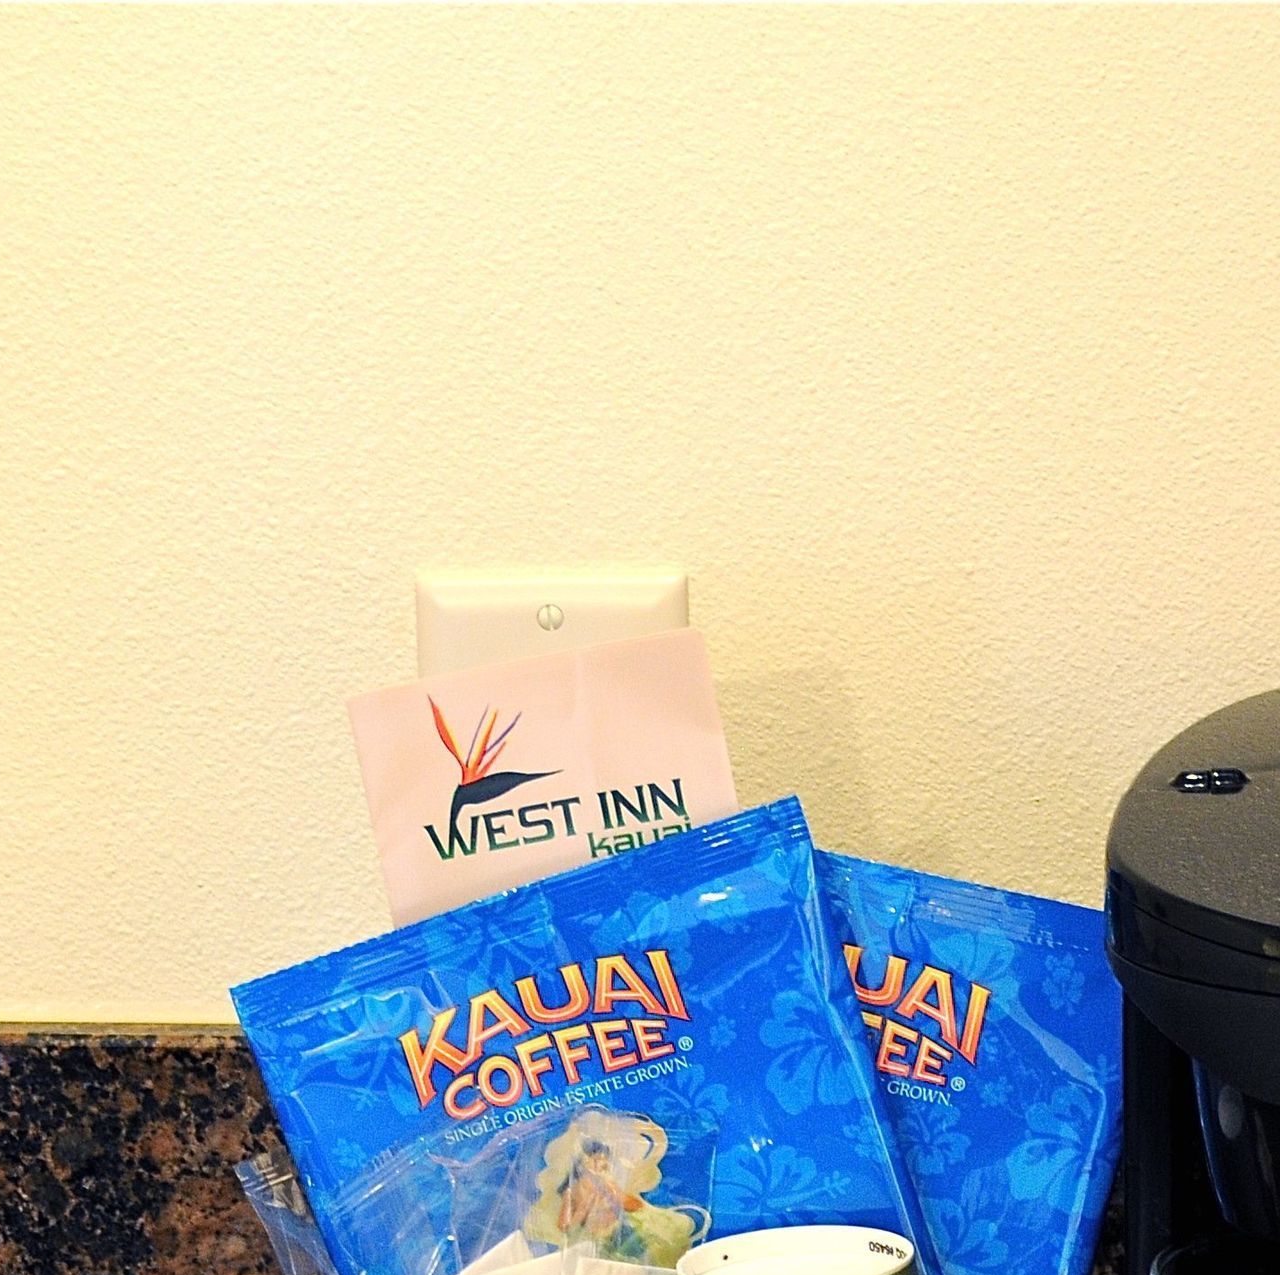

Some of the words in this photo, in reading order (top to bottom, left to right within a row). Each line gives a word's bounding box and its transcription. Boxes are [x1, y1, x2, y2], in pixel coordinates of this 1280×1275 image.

[424, 796, 581, 861] WEST
[597, 778, 689, 830] INN
[399, 949, 691, 1109] KAUAI
[442, 1018, 676, 1121] COFFEE
[445, 1114, 503, 1146] SINGLE
[566, 1078, 625, 1108] ESTATE
[624, 1055, 693, 1088] GROWN.
[886, 1079, 954, 1108] GROWN.
